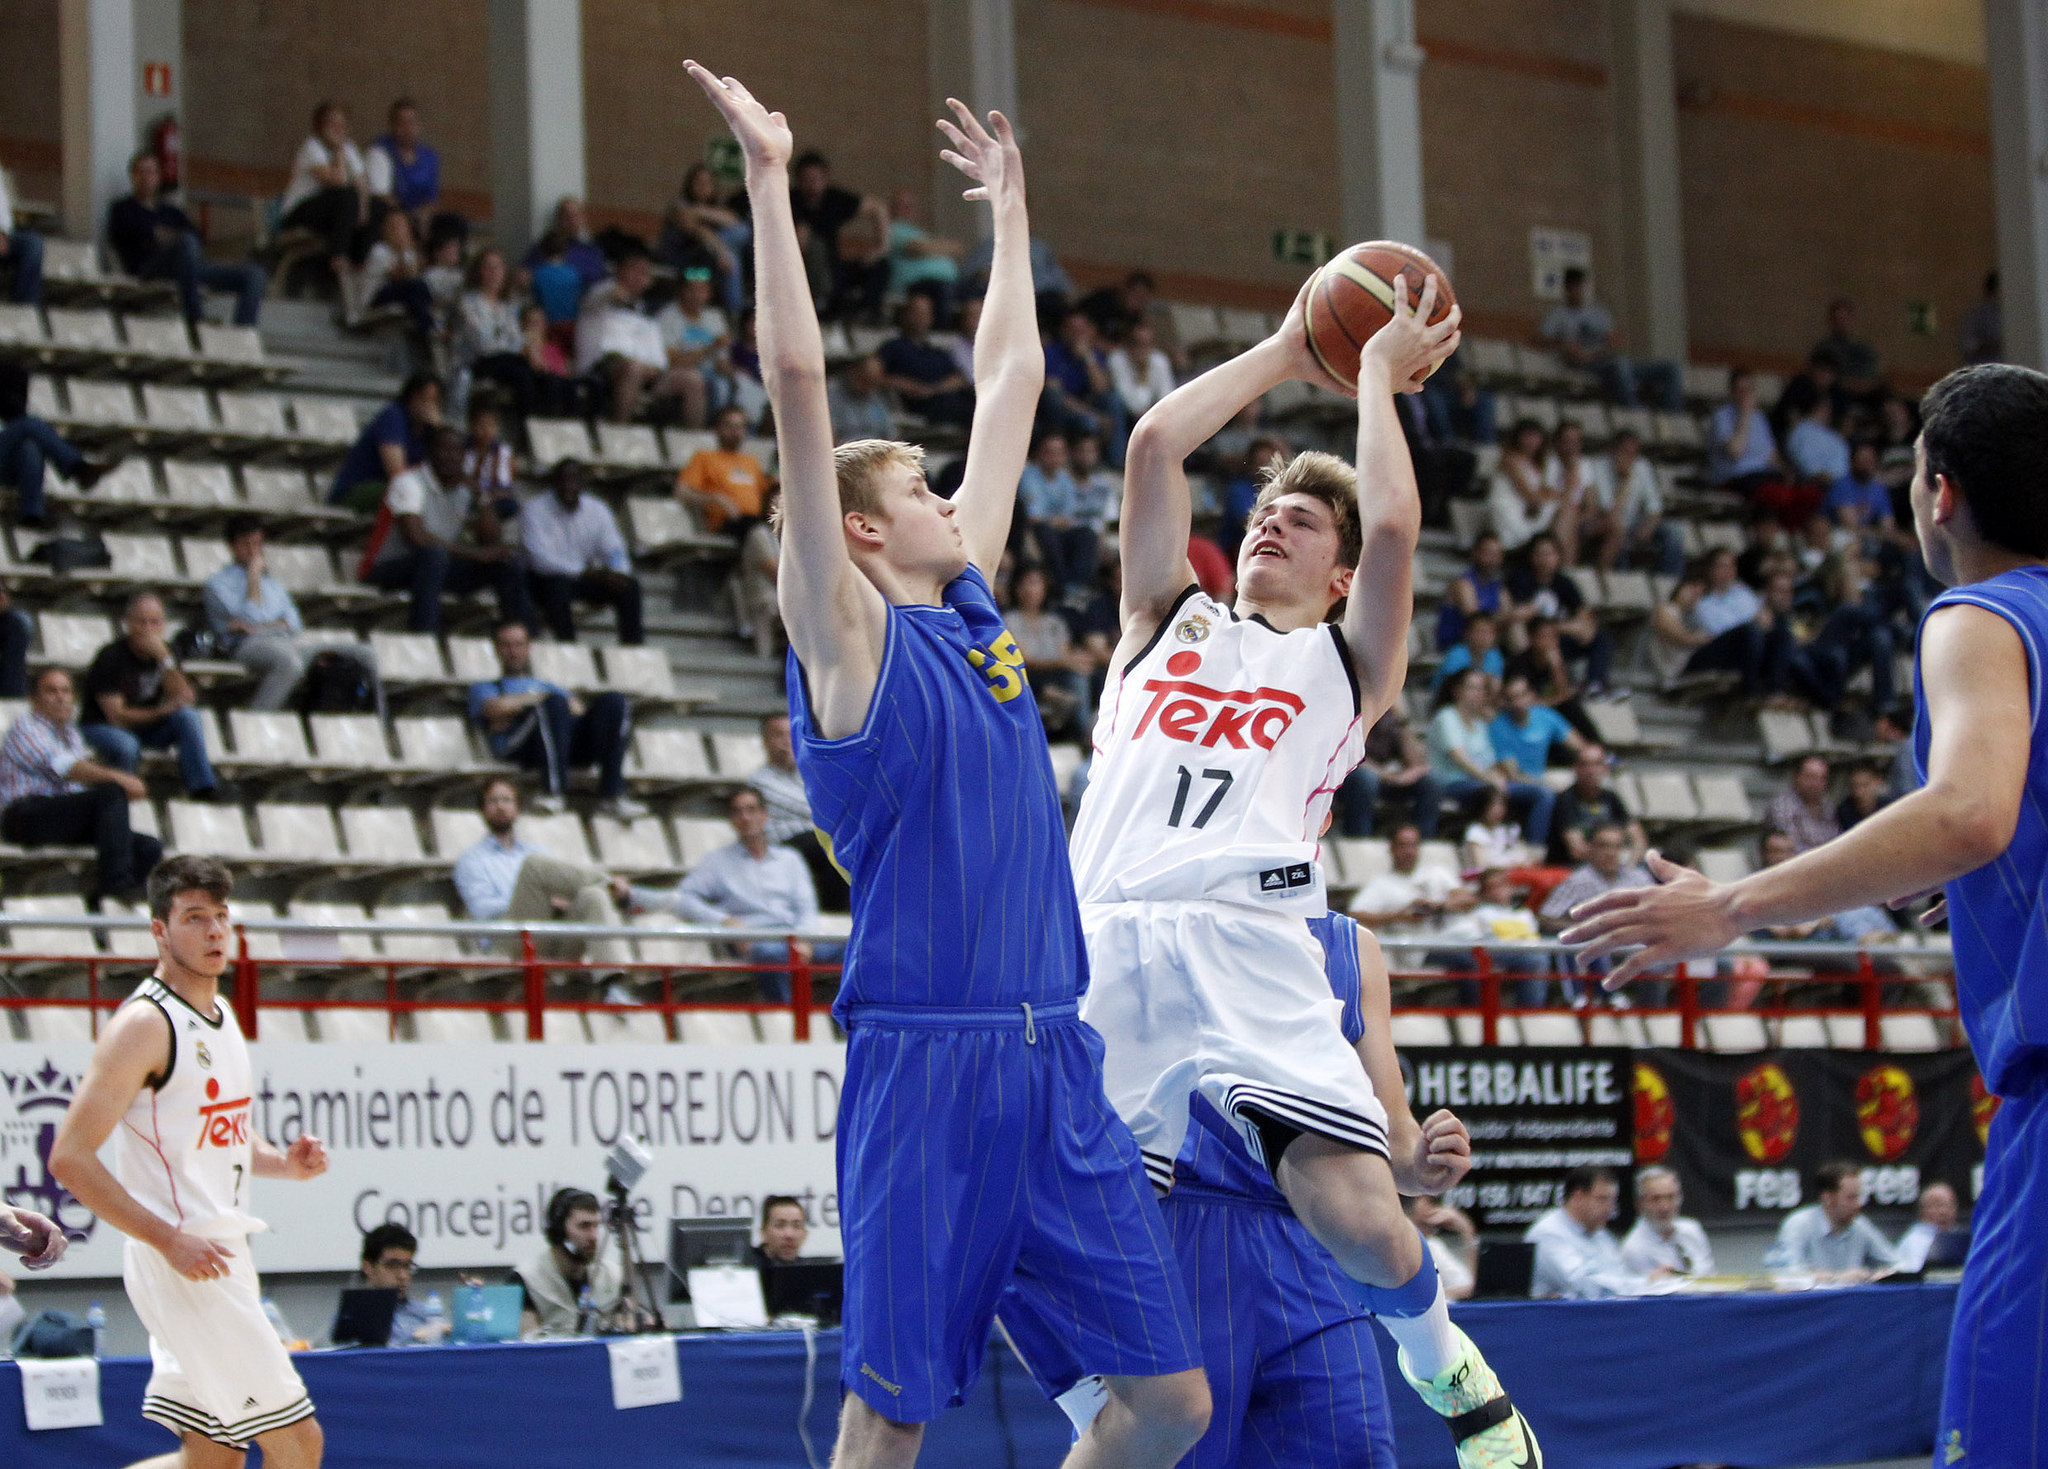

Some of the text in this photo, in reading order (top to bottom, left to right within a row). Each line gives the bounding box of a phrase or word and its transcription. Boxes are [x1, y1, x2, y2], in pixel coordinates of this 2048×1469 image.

[1167, 765, 1234, 830] 17
[251, 1066, 473, 1149] tamiento
[491, 1065, 544, 1147] de
[560, 1070, 794, 1146] TORREJON
[1418, 1060, 1616, 1106] HERBALIFE
[354, 1182, 546, 1250] Concejal
